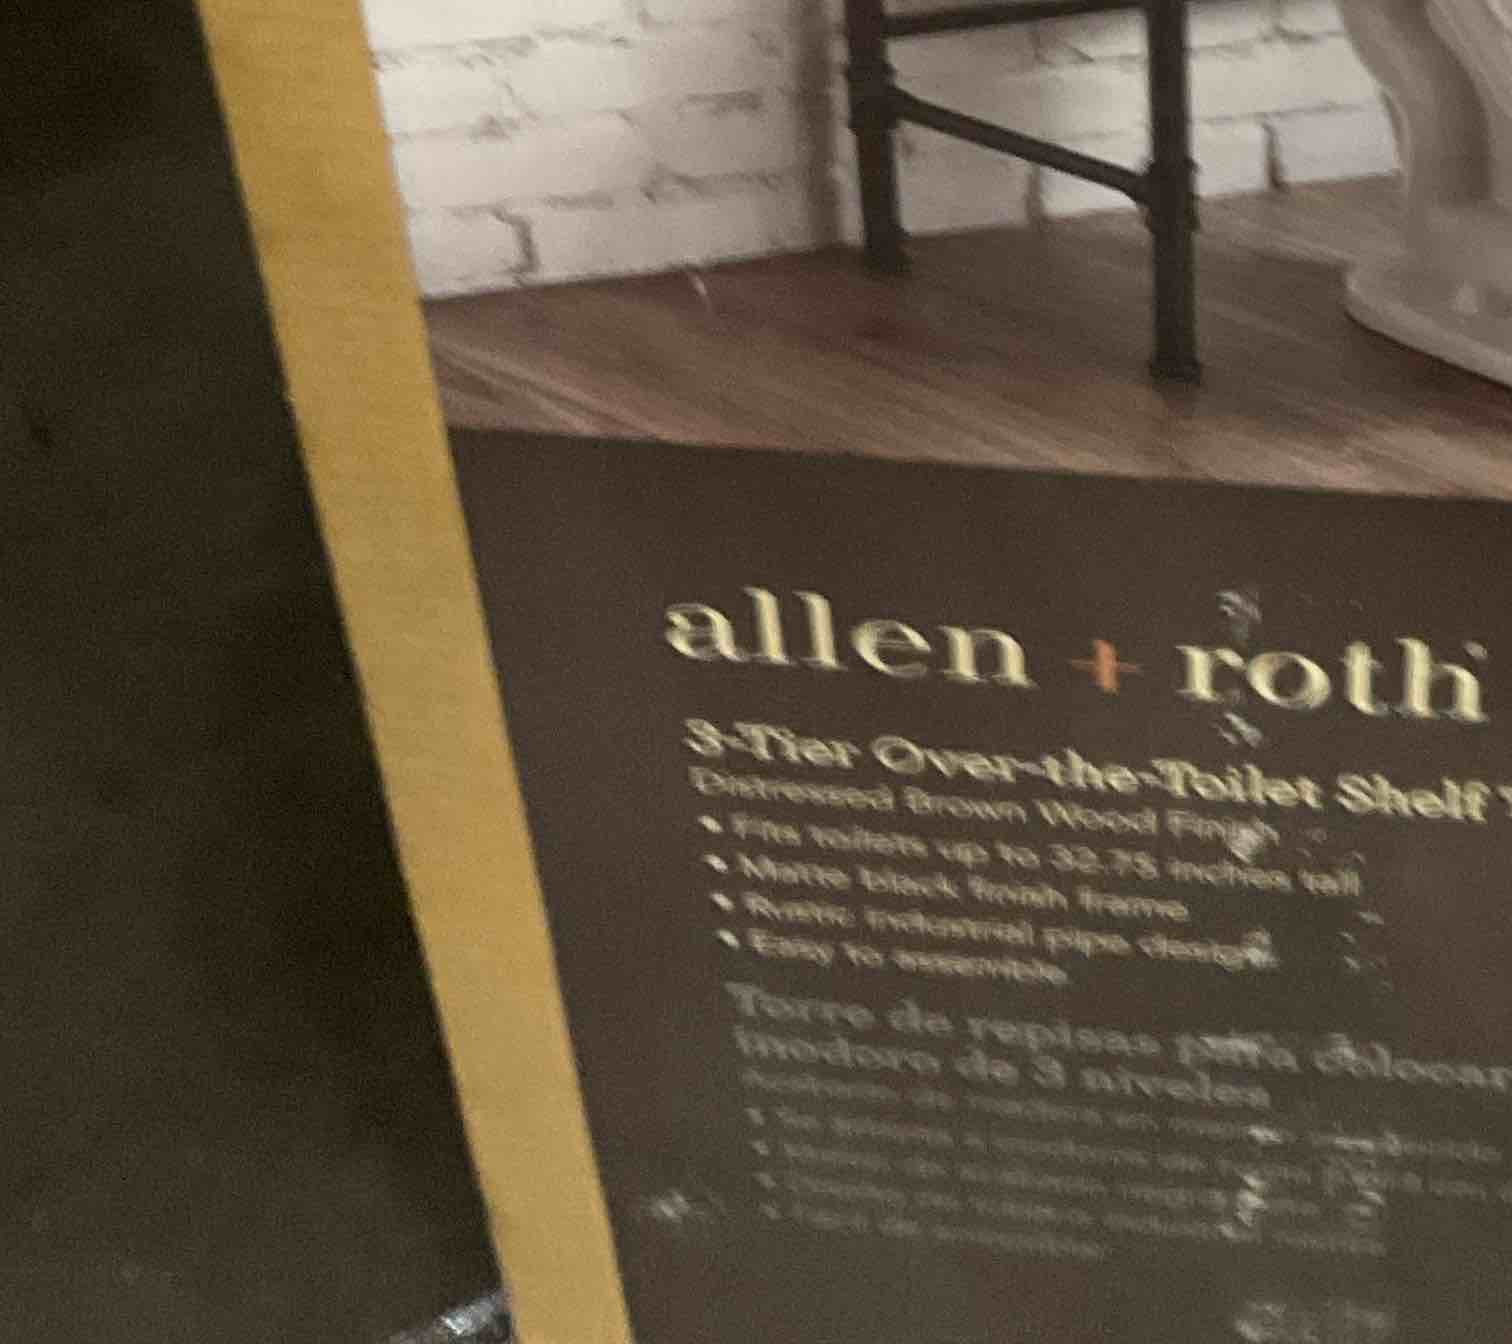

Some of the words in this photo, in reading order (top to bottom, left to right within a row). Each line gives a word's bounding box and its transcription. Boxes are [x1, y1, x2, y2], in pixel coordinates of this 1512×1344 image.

[663, 585, 1037, 690] allen
[1067, 638, 1143, 698] +
[1176, 637, 1486, 725] roth
[682, 716, 862, 770] 3-Tier
[870, 734, 1324, 812] Over-the-Toilet
[1336, 772, 1491, 825] Shelf
[686, 765, 895, 812] Distressed
[901, 785, 1028, 825] Brown
[1034, 798, 1159, 836] Wood
[735, 851, 852, 890] Matte
[856, 865, 961, 900] black
[965, 873, 1069, 912] finish
[1074, 885, 1190, 923] frame
[936, 841, 990, 871] up
[994, 839, 1042, 870] to
[1166, 857, 1293, 893] inches
[1297, 863, 1361, 898] tall
[745, 926, 834, 967] Easy
[840, 940, 885, 969] to
[1040, 925, 1133, 959] pipe
[722, 979, 876, 1030] Torre
[887, 998, 955, 1035] de
[964, 1016, 1163, 1056] repisas
[953, 1049, 1019, 1087] de
[1029, 1053, 1069, 1091] 3
[1077, 1066, 1272, 1109] niveles
